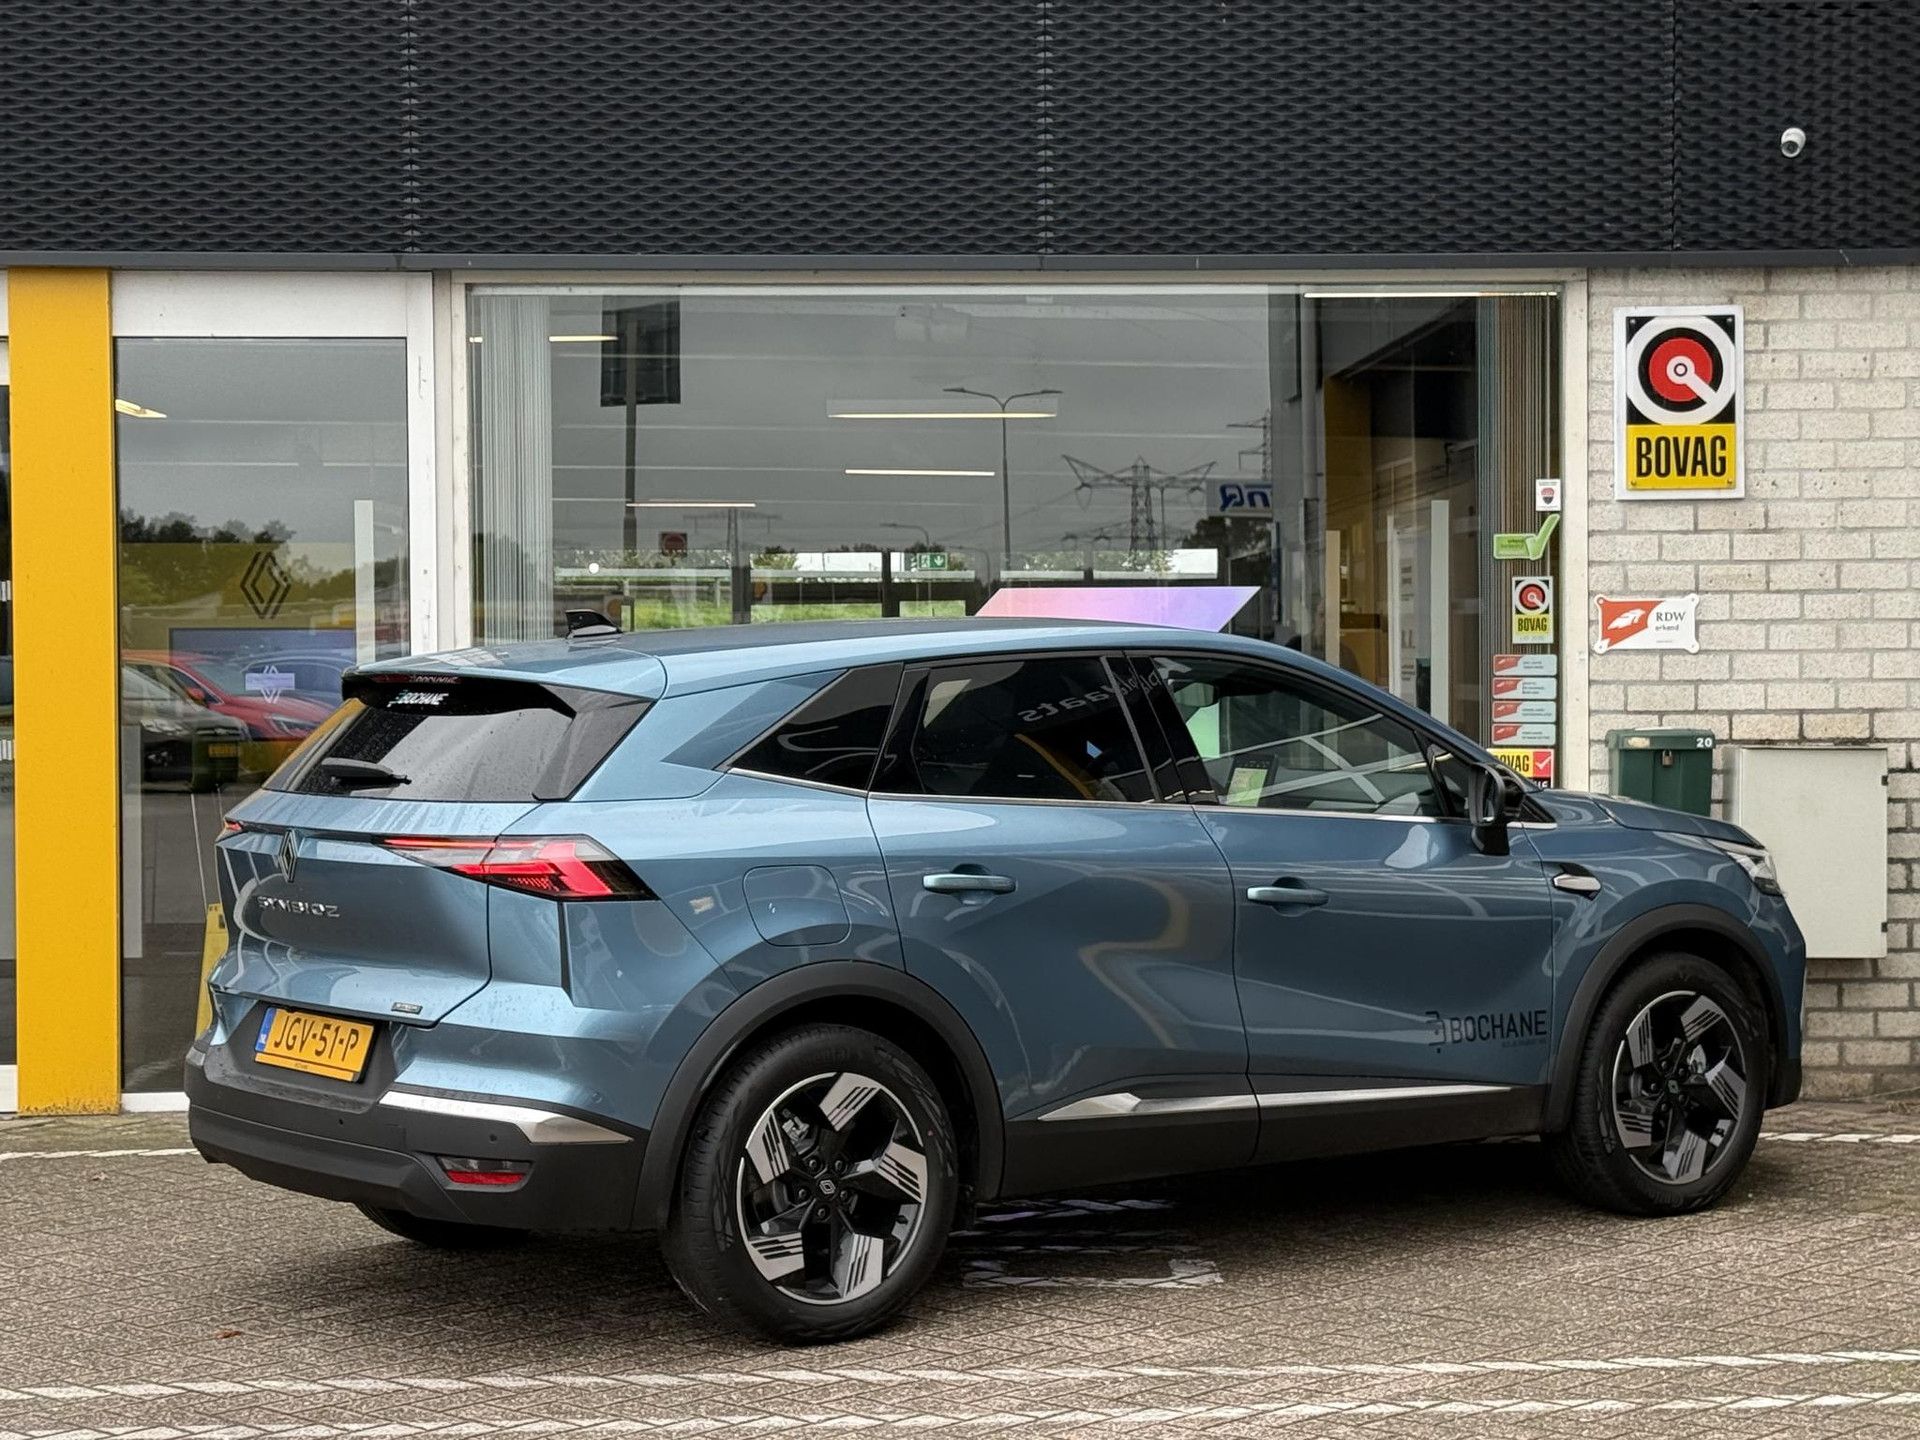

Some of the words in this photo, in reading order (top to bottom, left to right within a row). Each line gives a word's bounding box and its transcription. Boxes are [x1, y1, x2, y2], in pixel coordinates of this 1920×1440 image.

[1635, 434, 1727, 479] BOVAG
[1517, 617, 1548, 632] BOVAG
[1655, 611, 1686, 622] RDW
[1696, 737, 1713, 748] 20
[256, 895, 341, 918] SYMBIOZ
[273, 1015, 360, 1062] JGV-51-P
[1450, 1009, 1548, 1045] BOCHANE
